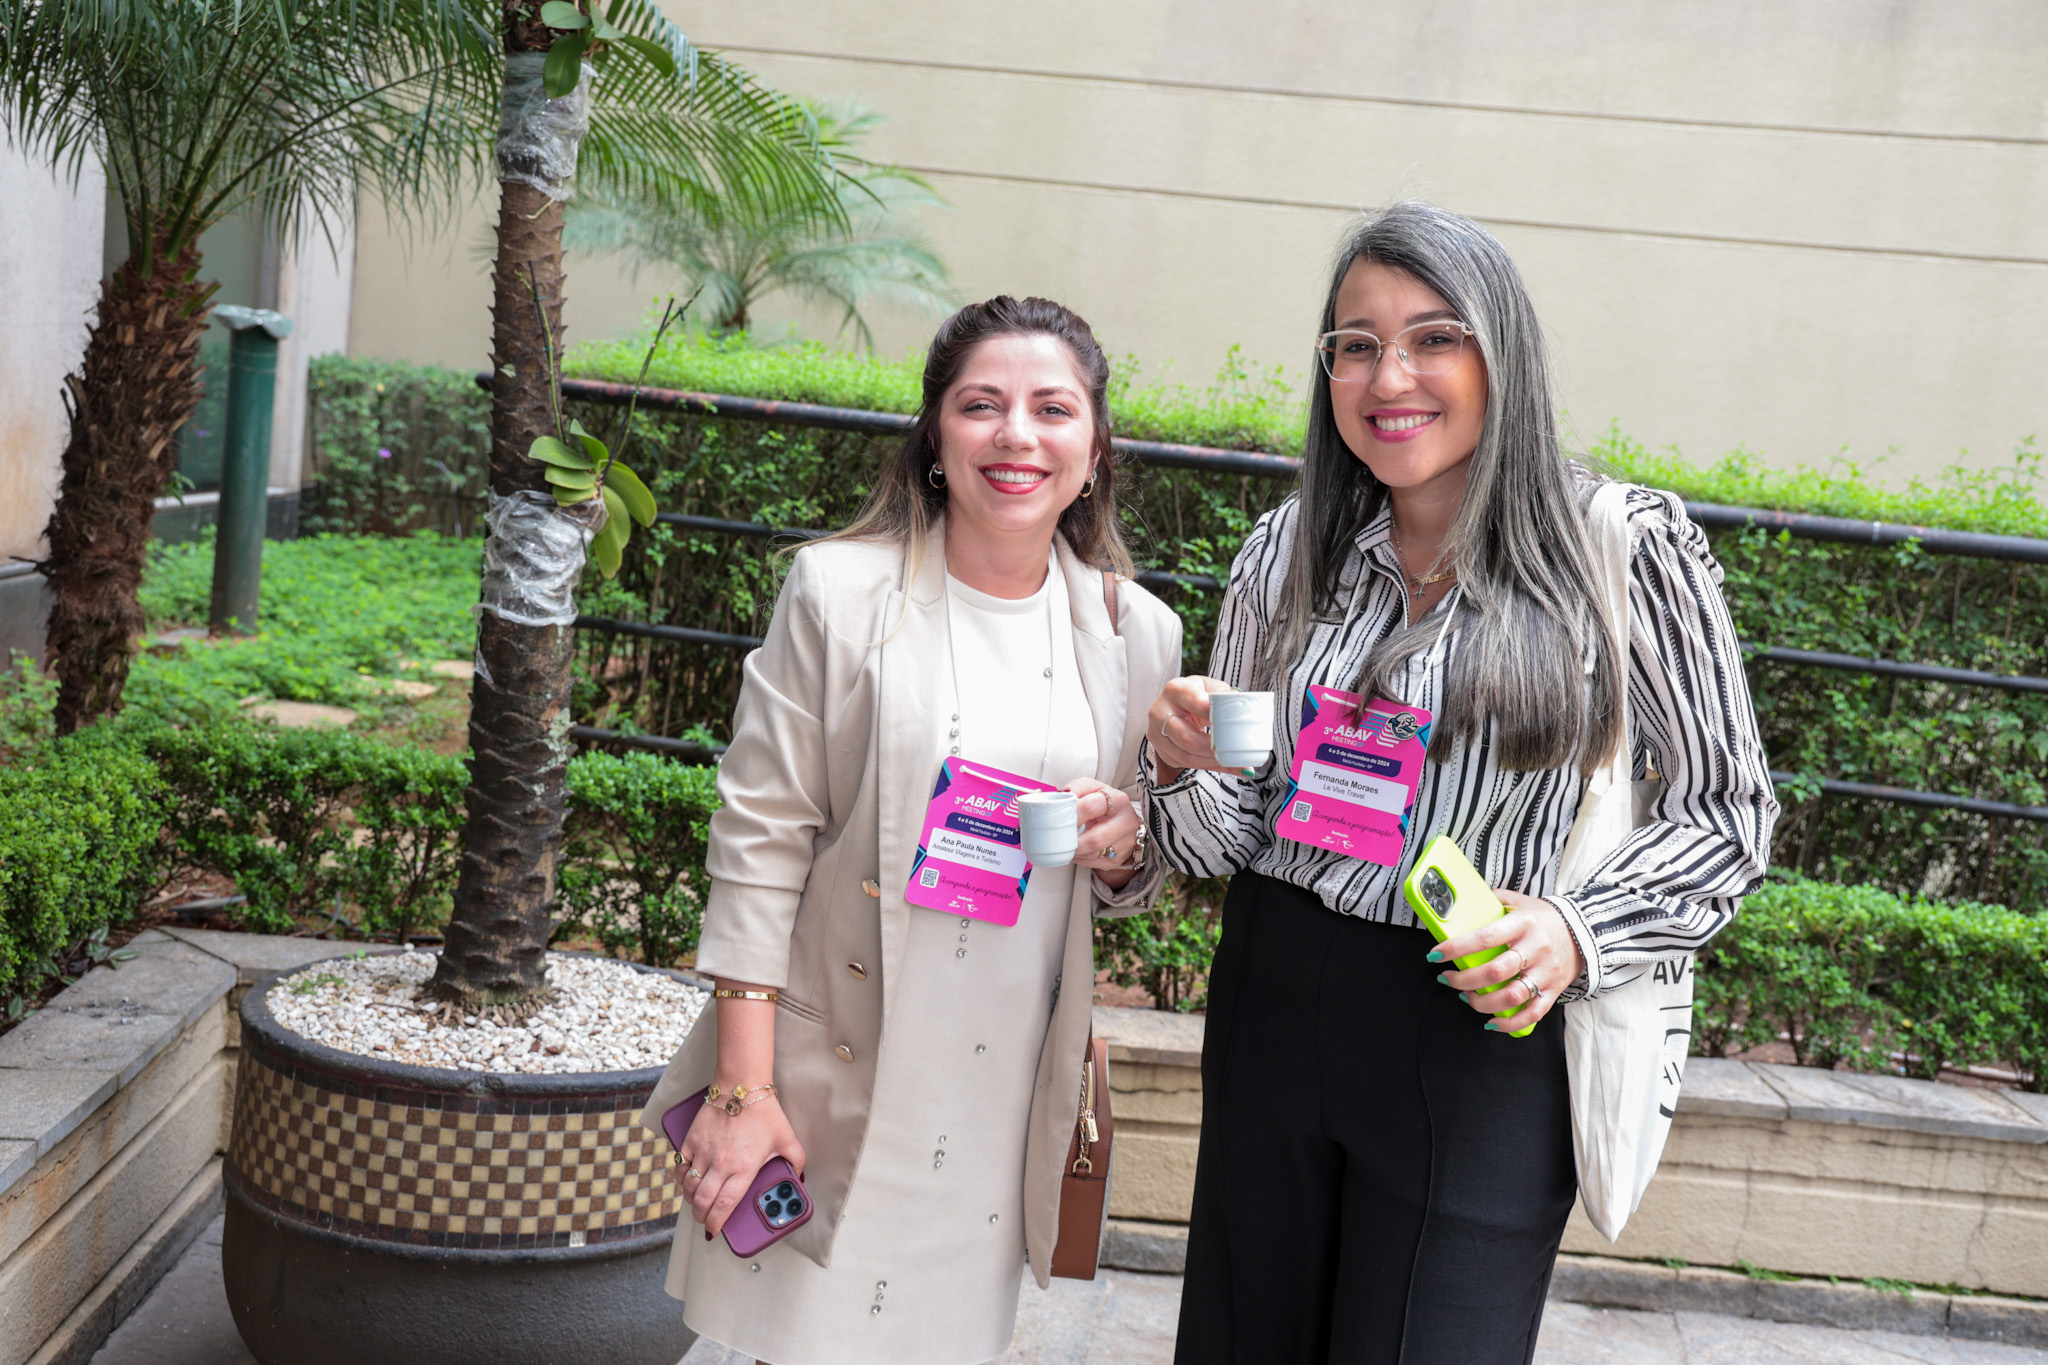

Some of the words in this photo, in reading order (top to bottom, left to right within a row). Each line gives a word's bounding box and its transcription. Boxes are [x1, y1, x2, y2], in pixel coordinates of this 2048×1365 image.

[1334, 724, 1373, 742] ABAV
[1347, 752, 1370, 762] dezembro
[1377, 759, 1390, 767] 2024
[1313, 771, 1349, 786] Fernanda
[1350, 780, 1379, 795] Moraes
[1323, 783, 1332, 791] Le
[1333, 786, 1345, 794] Vive
[1347, 789, 1365, 799] Travel
[964, 795, 1001, 812] ABAV
[975, 821, 996, 831] dezembro
[1002, 827, 1014, 836] 2024
[1312, 809, 1346, 826] Acompanhe
[1350, 822, 1396, 837] programação!
[932, 843, 954, 853] Amatour
[955, 848, 976, 859] Viagens
[981, 855, 1002, 866] Turismo
[941, 836, 955, 846] Ana
[956, 840, 975, 851] Paula
[975, 845, 997, 857] Nunes
[939, 875, 971, 890] Acompanhe
[974, 884, 1015, 900] programação!
